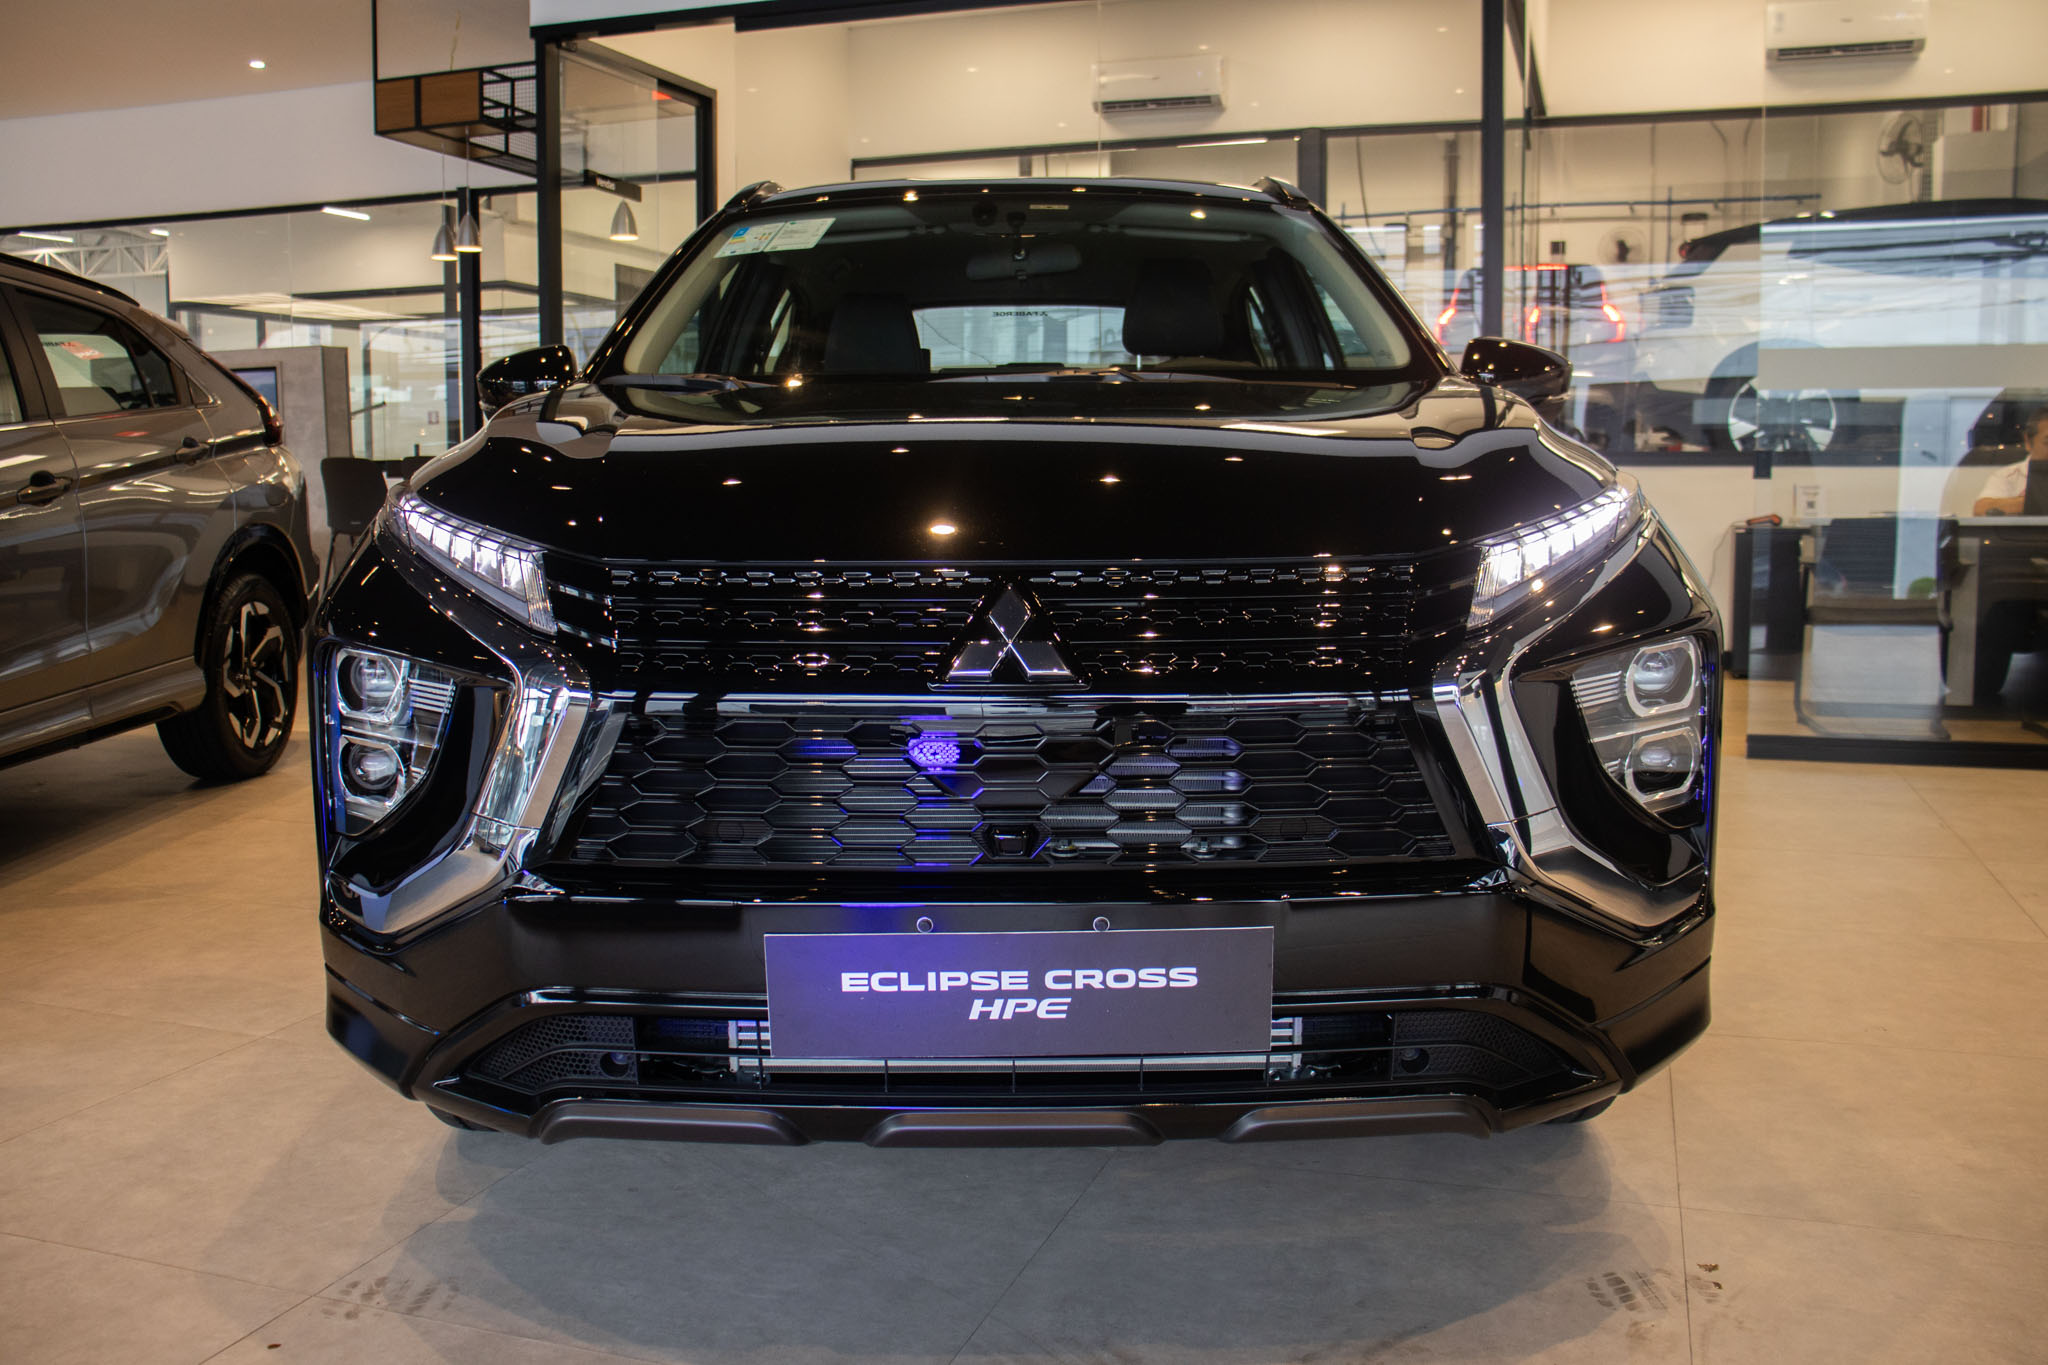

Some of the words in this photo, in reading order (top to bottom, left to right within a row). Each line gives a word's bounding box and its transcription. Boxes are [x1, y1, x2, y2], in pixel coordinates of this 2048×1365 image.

[841, 971, 1029, 992] ECLIPSE
[1044, 967, 1198, 990] CROSS
[968, 997, 1072, 1020] HPE
